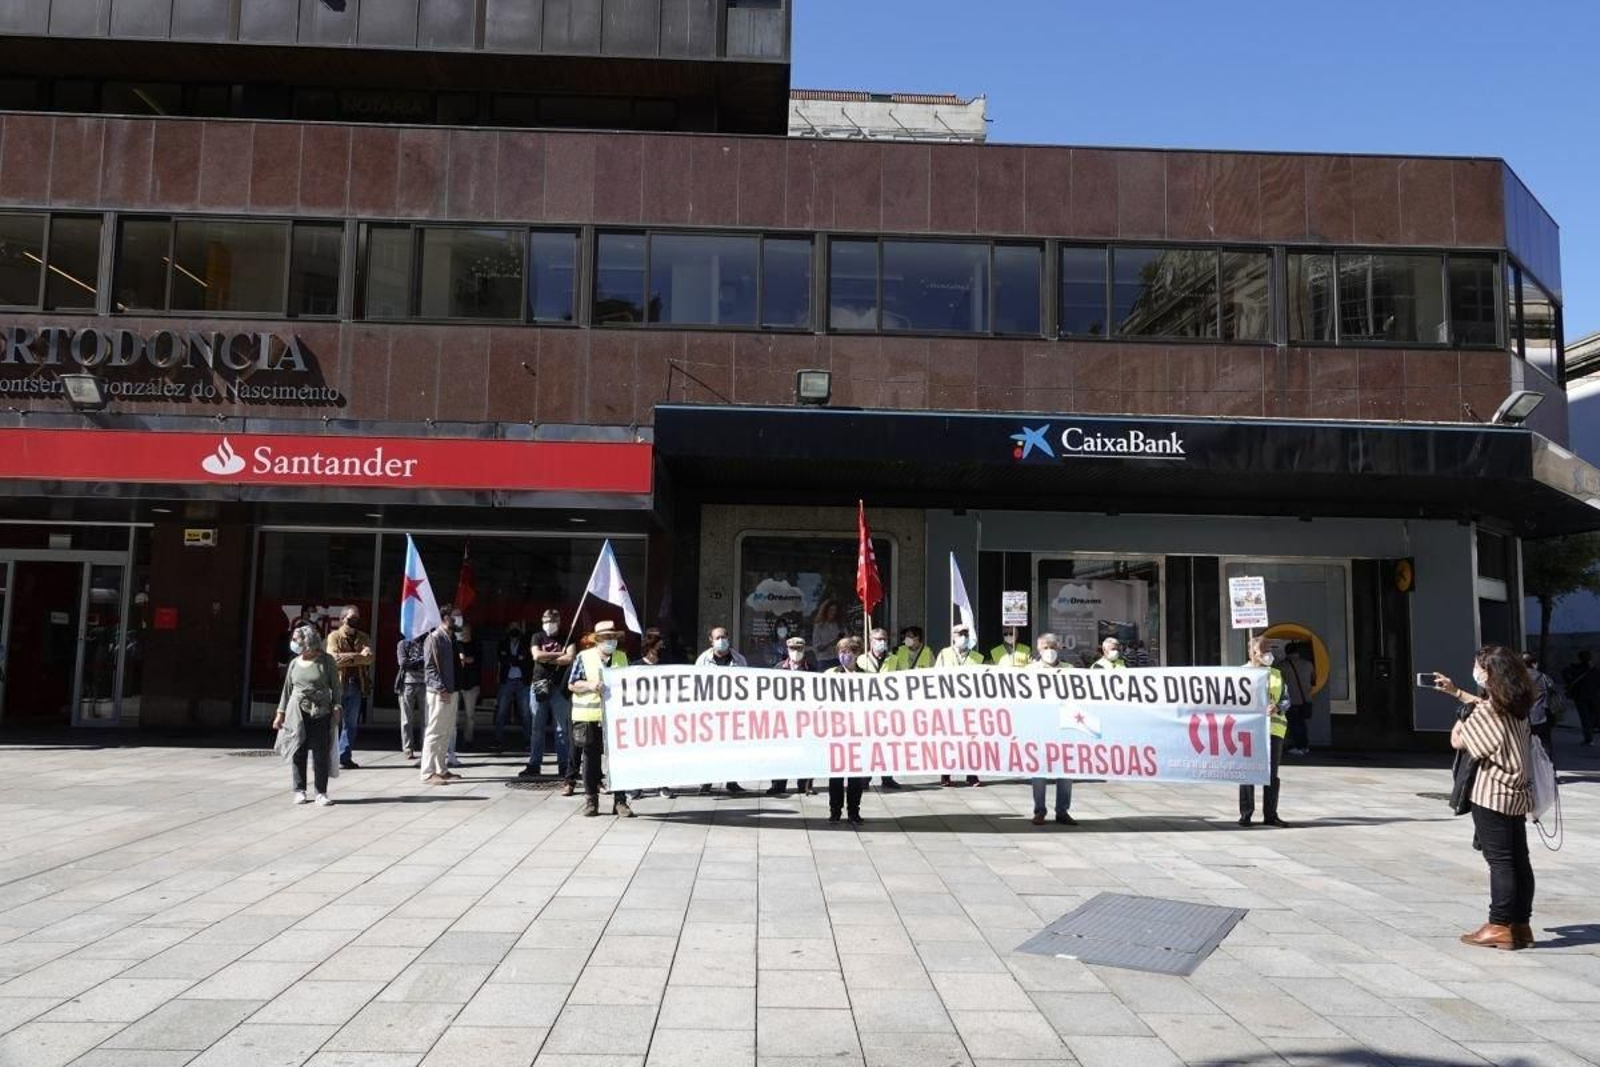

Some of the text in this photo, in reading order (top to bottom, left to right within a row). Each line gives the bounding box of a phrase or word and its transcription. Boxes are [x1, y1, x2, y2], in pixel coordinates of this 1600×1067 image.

[0, 326, 309, 371] RTODONCIA
[191, 379, 217, 398] do
[224, 379, 339, 401] Nascimento
[1061, 427, 1186, 454] CaixaBank
[253, 445, 418, 477] Santander
[621, 669, 1252, 707] LOITEMOS POR UNHAS PENSIÓNS PÚBLICAS DIGNAS
[615, 705, 1013, 750] E UN SISTEMA PÚBLICO GALEGO
[1188, 712, 1252, 758] CIG
[829, 736, 1158, 777] DE ATENCIÓN ÁS PERSOAS
